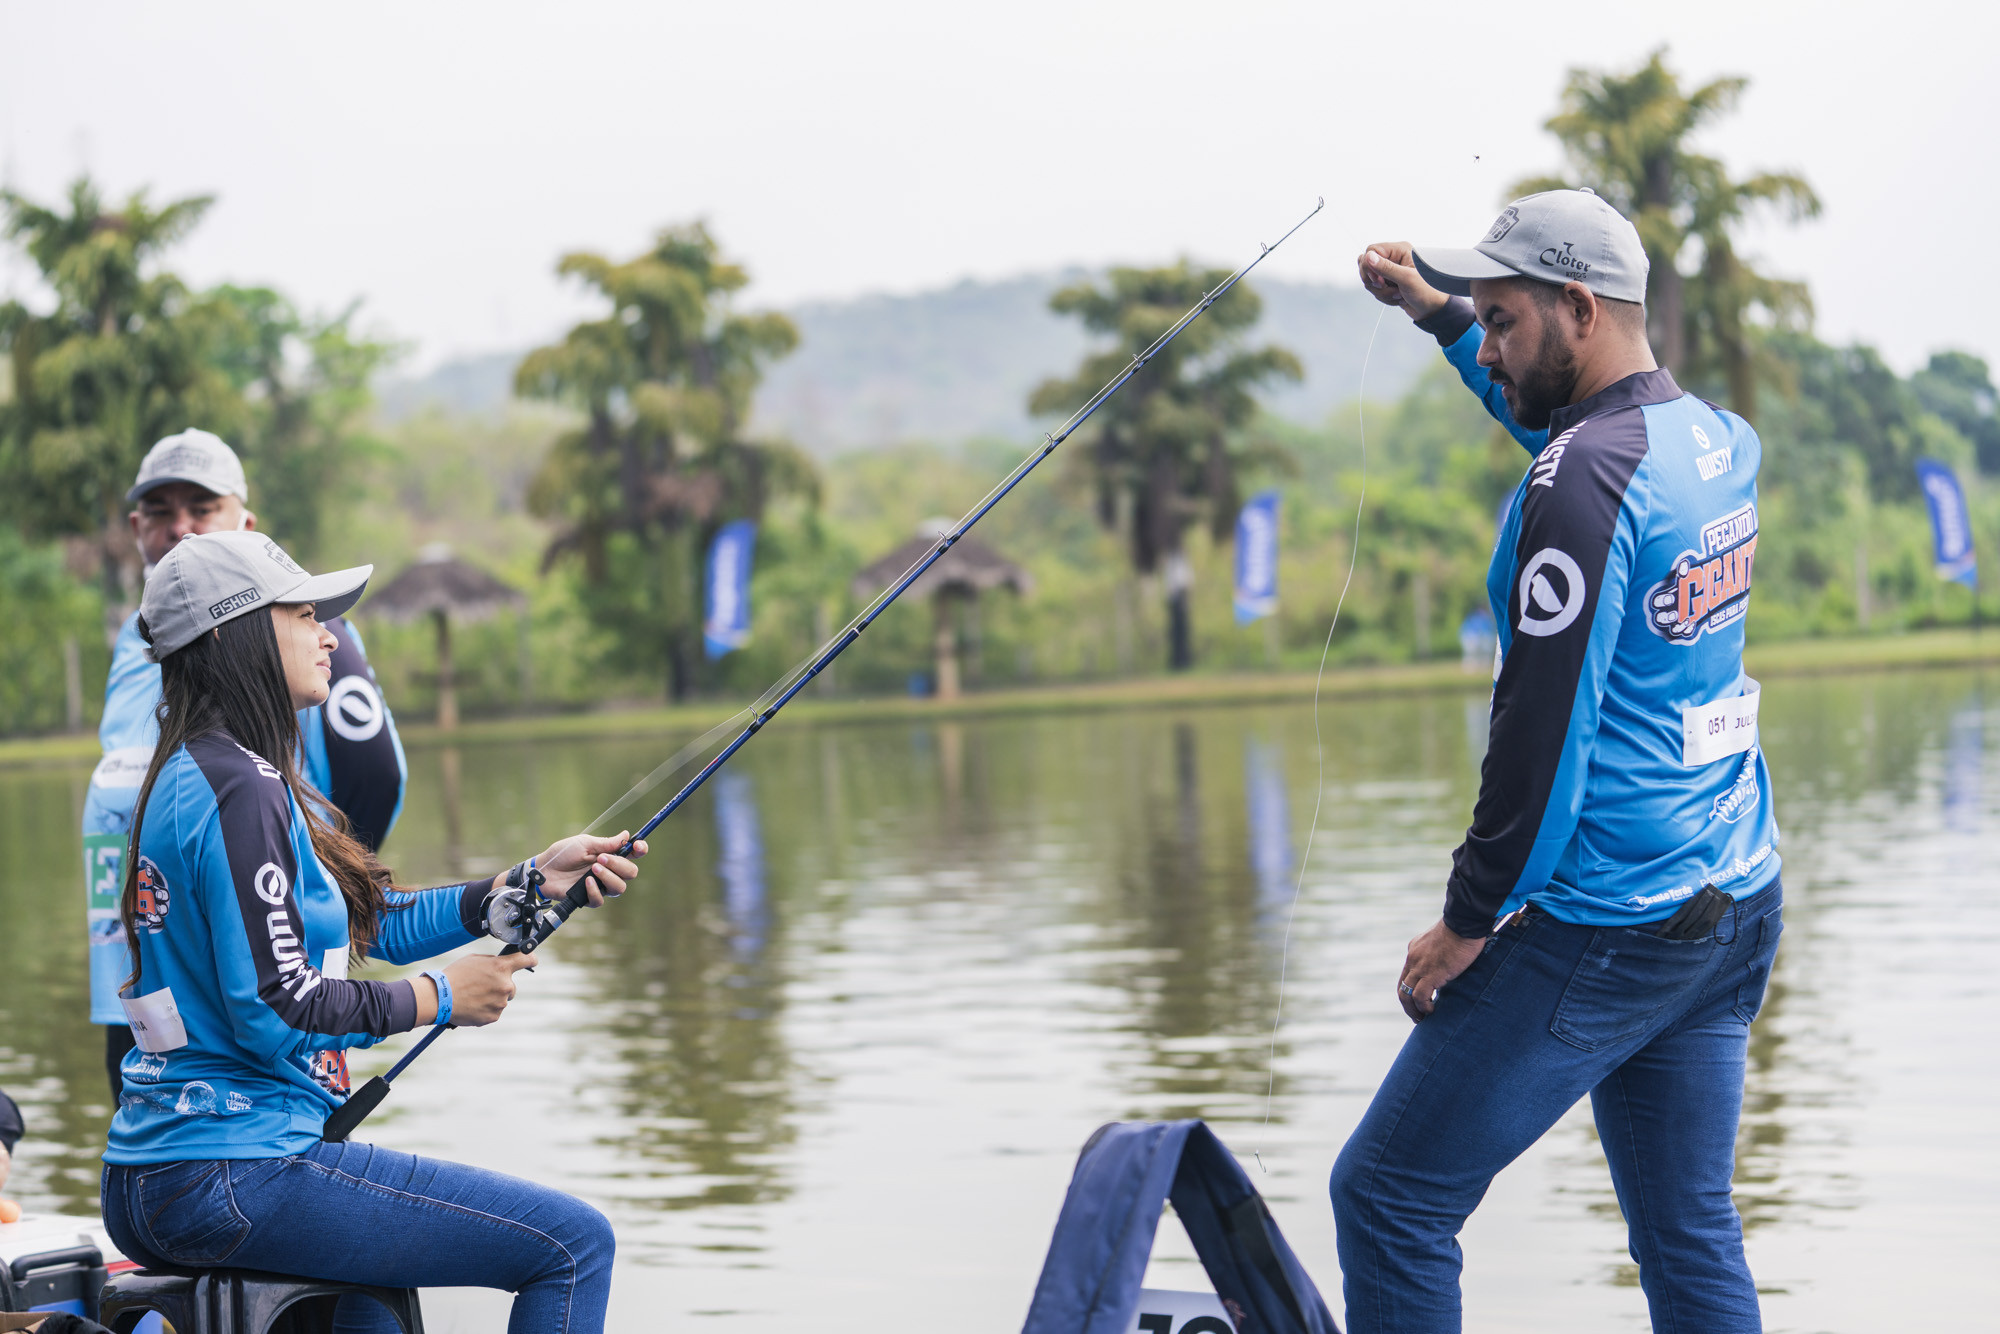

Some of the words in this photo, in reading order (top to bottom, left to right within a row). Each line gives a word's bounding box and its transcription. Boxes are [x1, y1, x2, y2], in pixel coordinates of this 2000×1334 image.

[1531, 420, 1587, 488] UISTY
[1695, 446, 1732, 481] QUISTY
[1706, 509, 1754, 555] PEGANDO
[1708, 715, 1726, 736] 051
[1700, 867, 1736, 888] PARQUE
